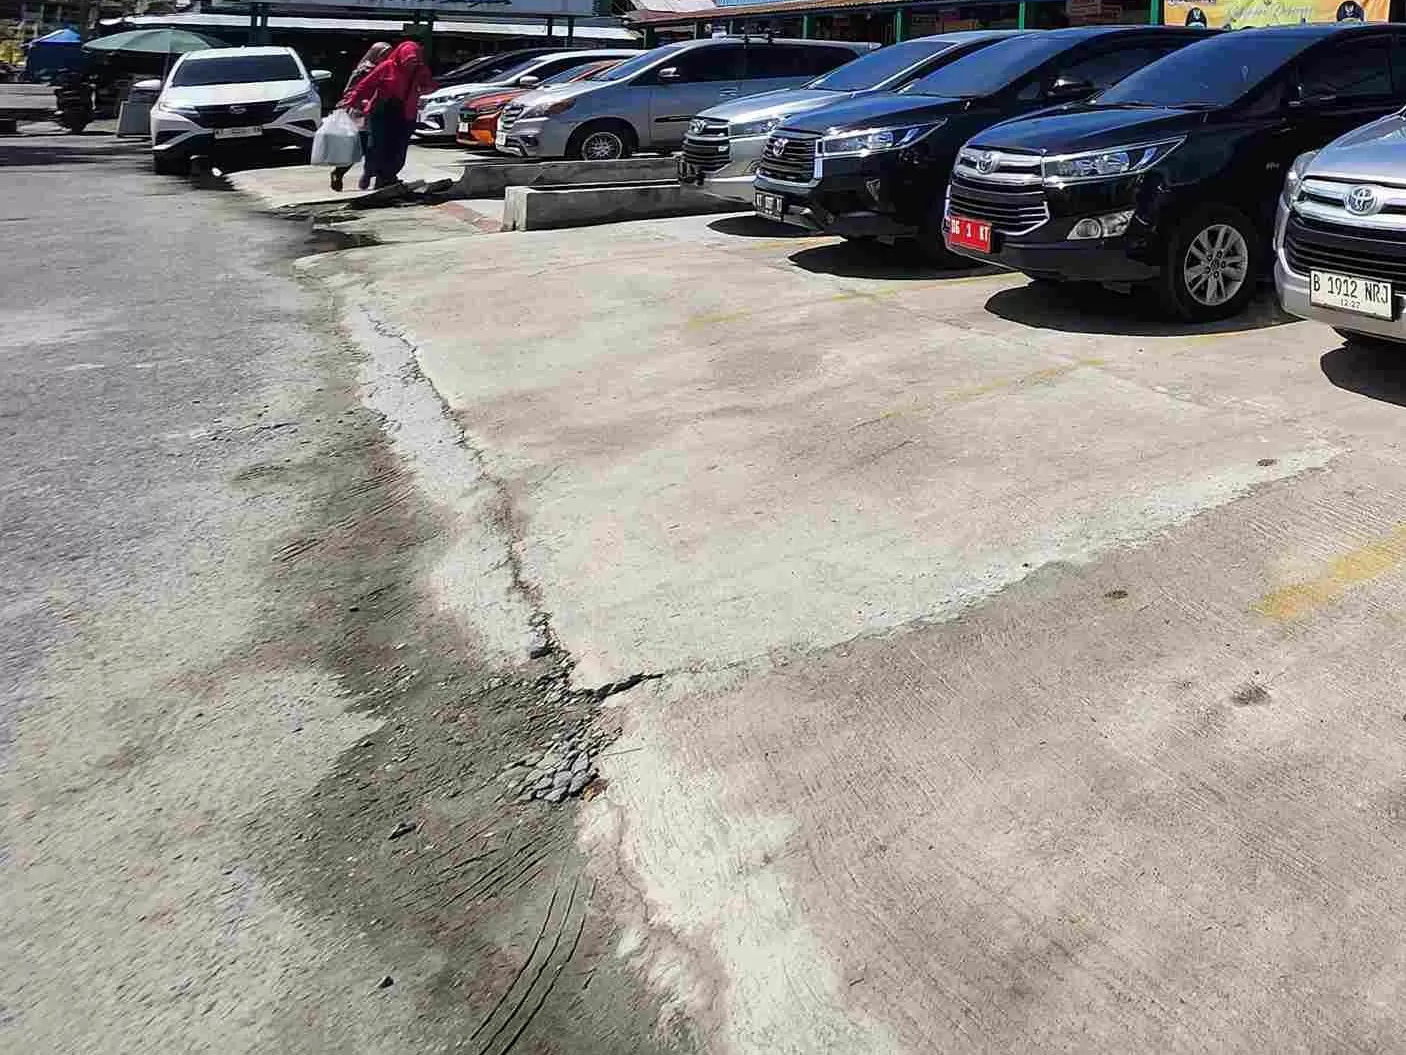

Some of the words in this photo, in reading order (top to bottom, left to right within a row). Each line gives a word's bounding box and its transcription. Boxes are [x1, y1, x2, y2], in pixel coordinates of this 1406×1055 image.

[966, 223, 972, 237] 1
[1313, 274, 1321, 292] B
[1327, 276, 1358, 299] 1912
[1364, 282, 1389, 304] NRJ
